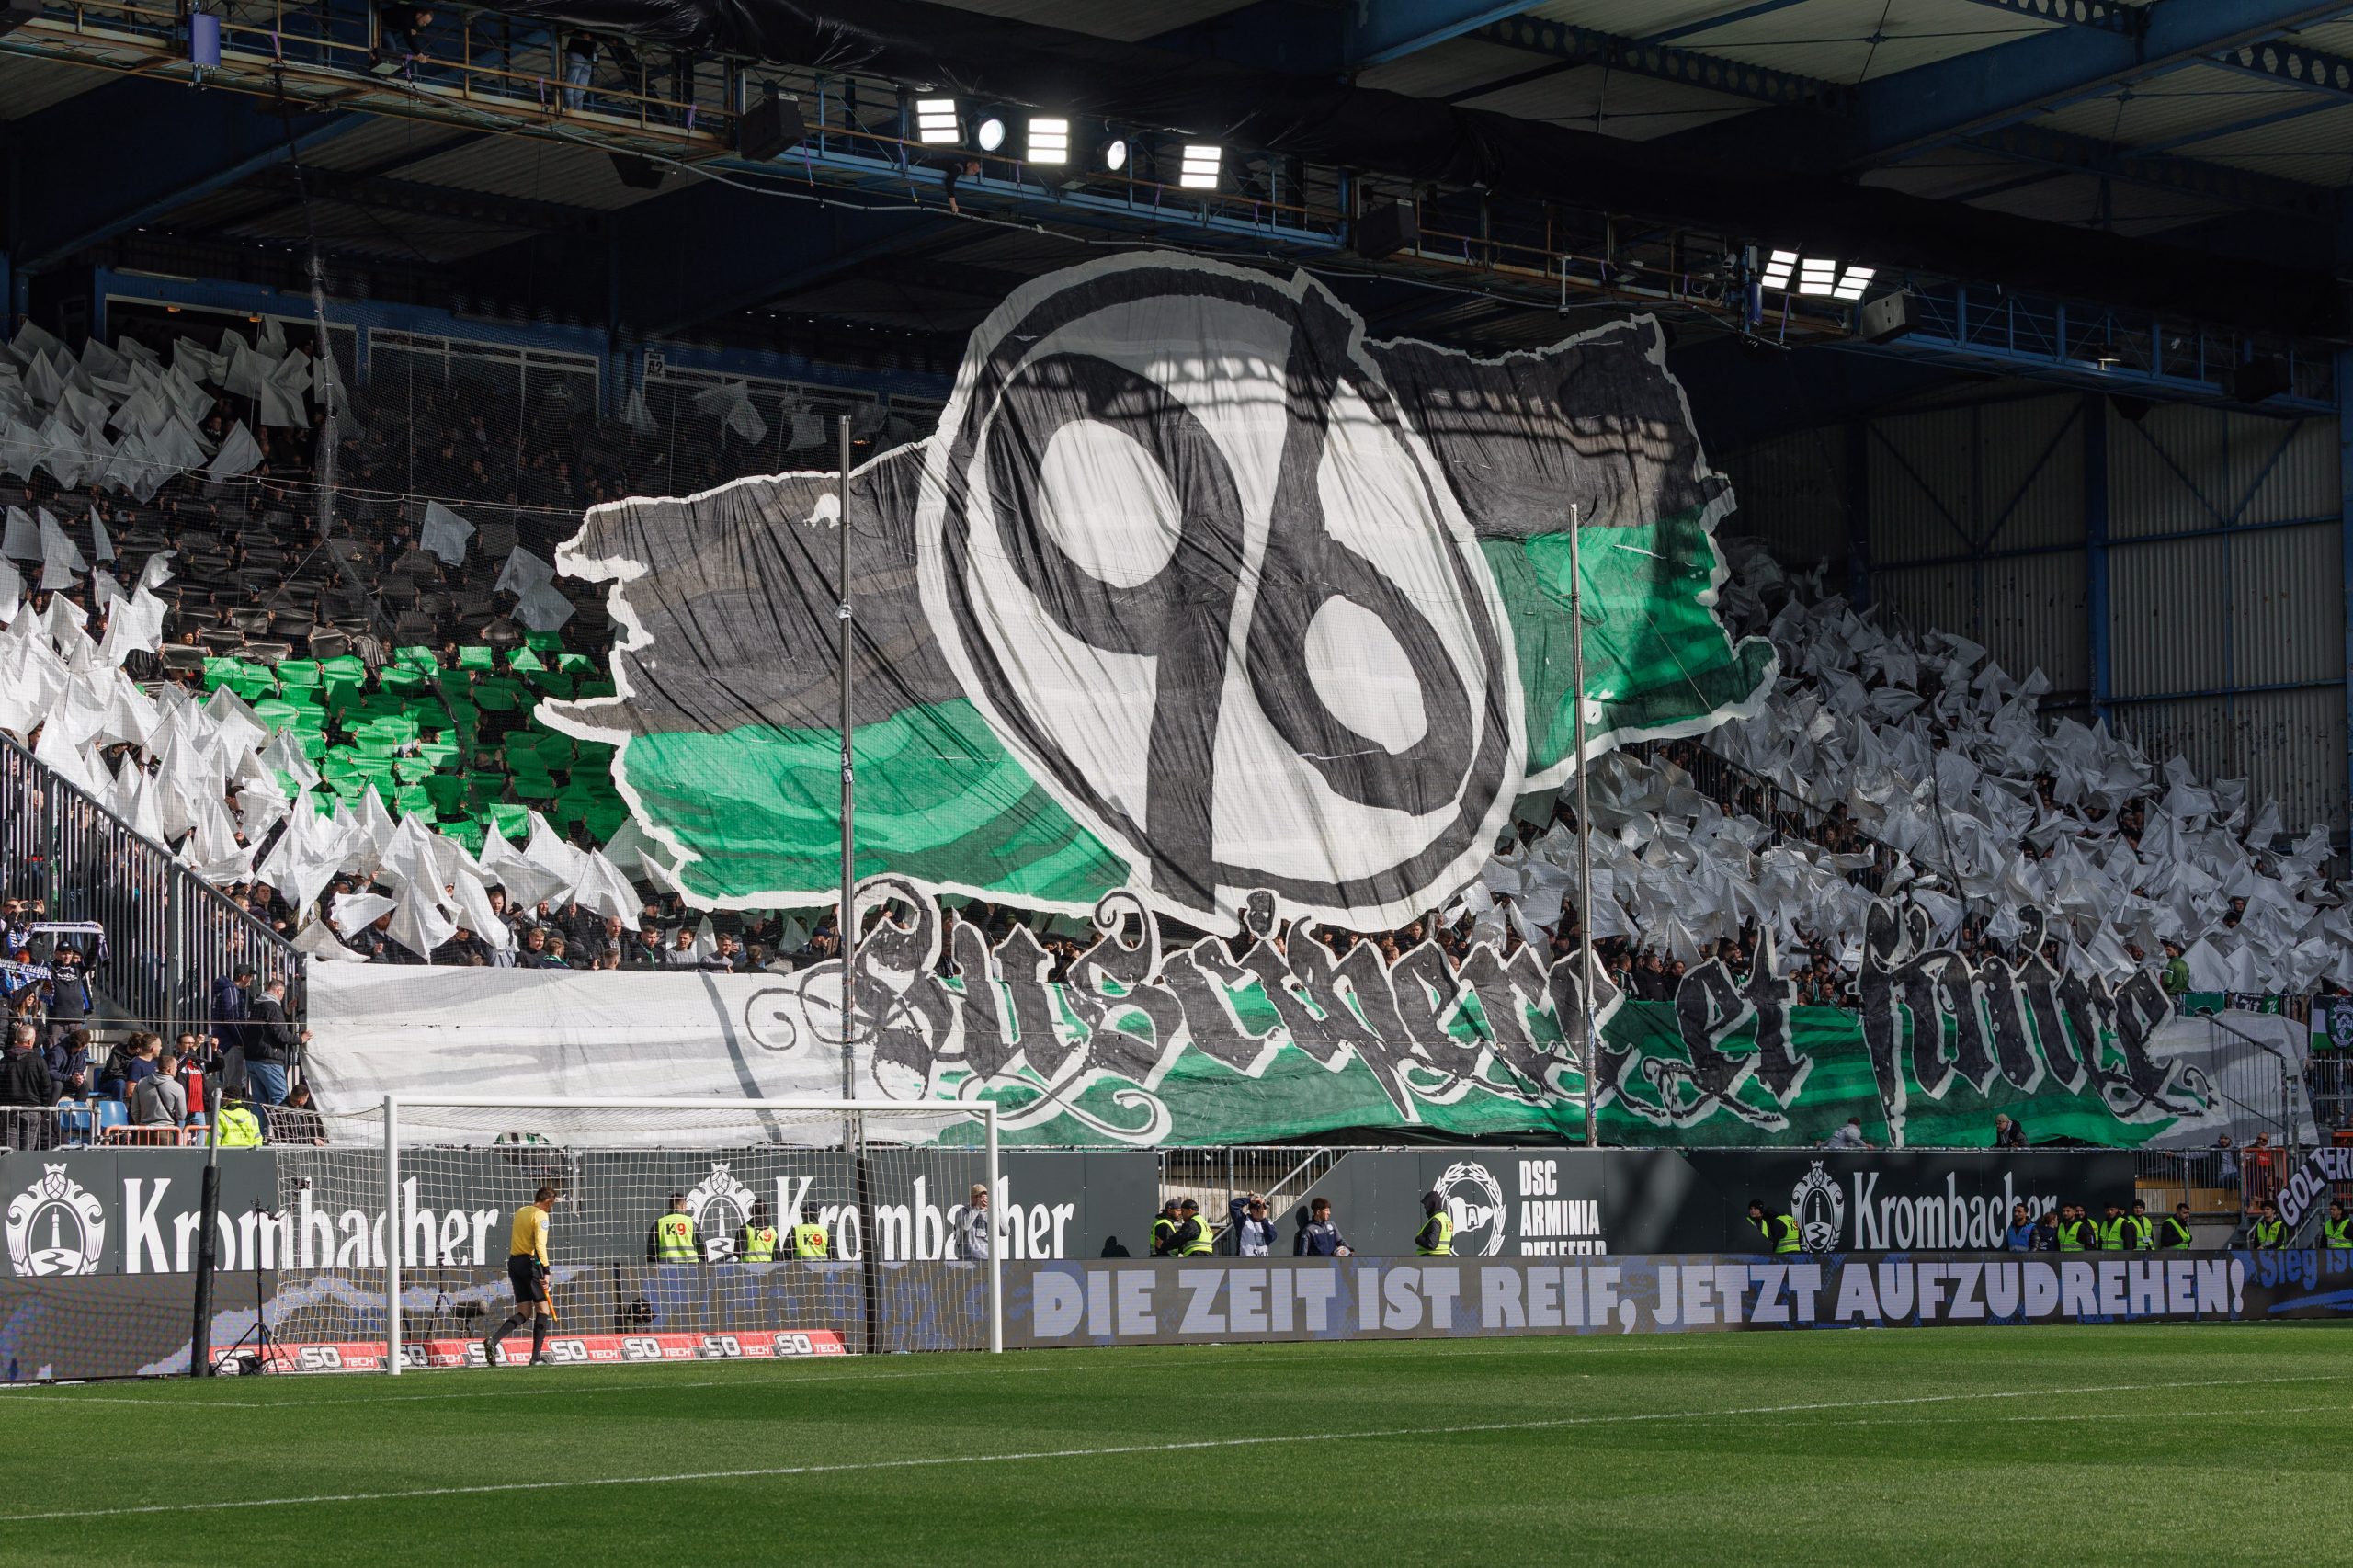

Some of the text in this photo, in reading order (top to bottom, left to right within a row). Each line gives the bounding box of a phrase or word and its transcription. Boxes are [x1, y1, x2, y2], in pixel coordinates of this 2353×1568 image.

[985, 273, 1472, 914] 96
[1518, 1160, 1558, 1196] DSC
[2278, 1147, 2353, 1227] GOLTER
[776, 1175, 1074, 1261] Krombher
[1519, 1199, 1601, 1237] ARMINIA
[665, 1223, 687, 1236] K9
[754, 1228, 772, 1243] K9
[802, 1233, 823, 1246] K9
[1033, 1257, 2245, 1338] DIE ZEIT IST REIF, JETZT AUFZUDREHEN!
[589, 1350, 619, 1359] TECH
[664, 1346, 691, 1358] TECH
[743, 1346, 770, 1356] TECH
[814, 1344, 841, 1353] TECH
[266, 1358, 292, 1369] ECH
[344, 1357, 374, 1368] TECH
[432, 1354, 460, 1365] TECH
[509, 1353, 532, 1363] TEC
